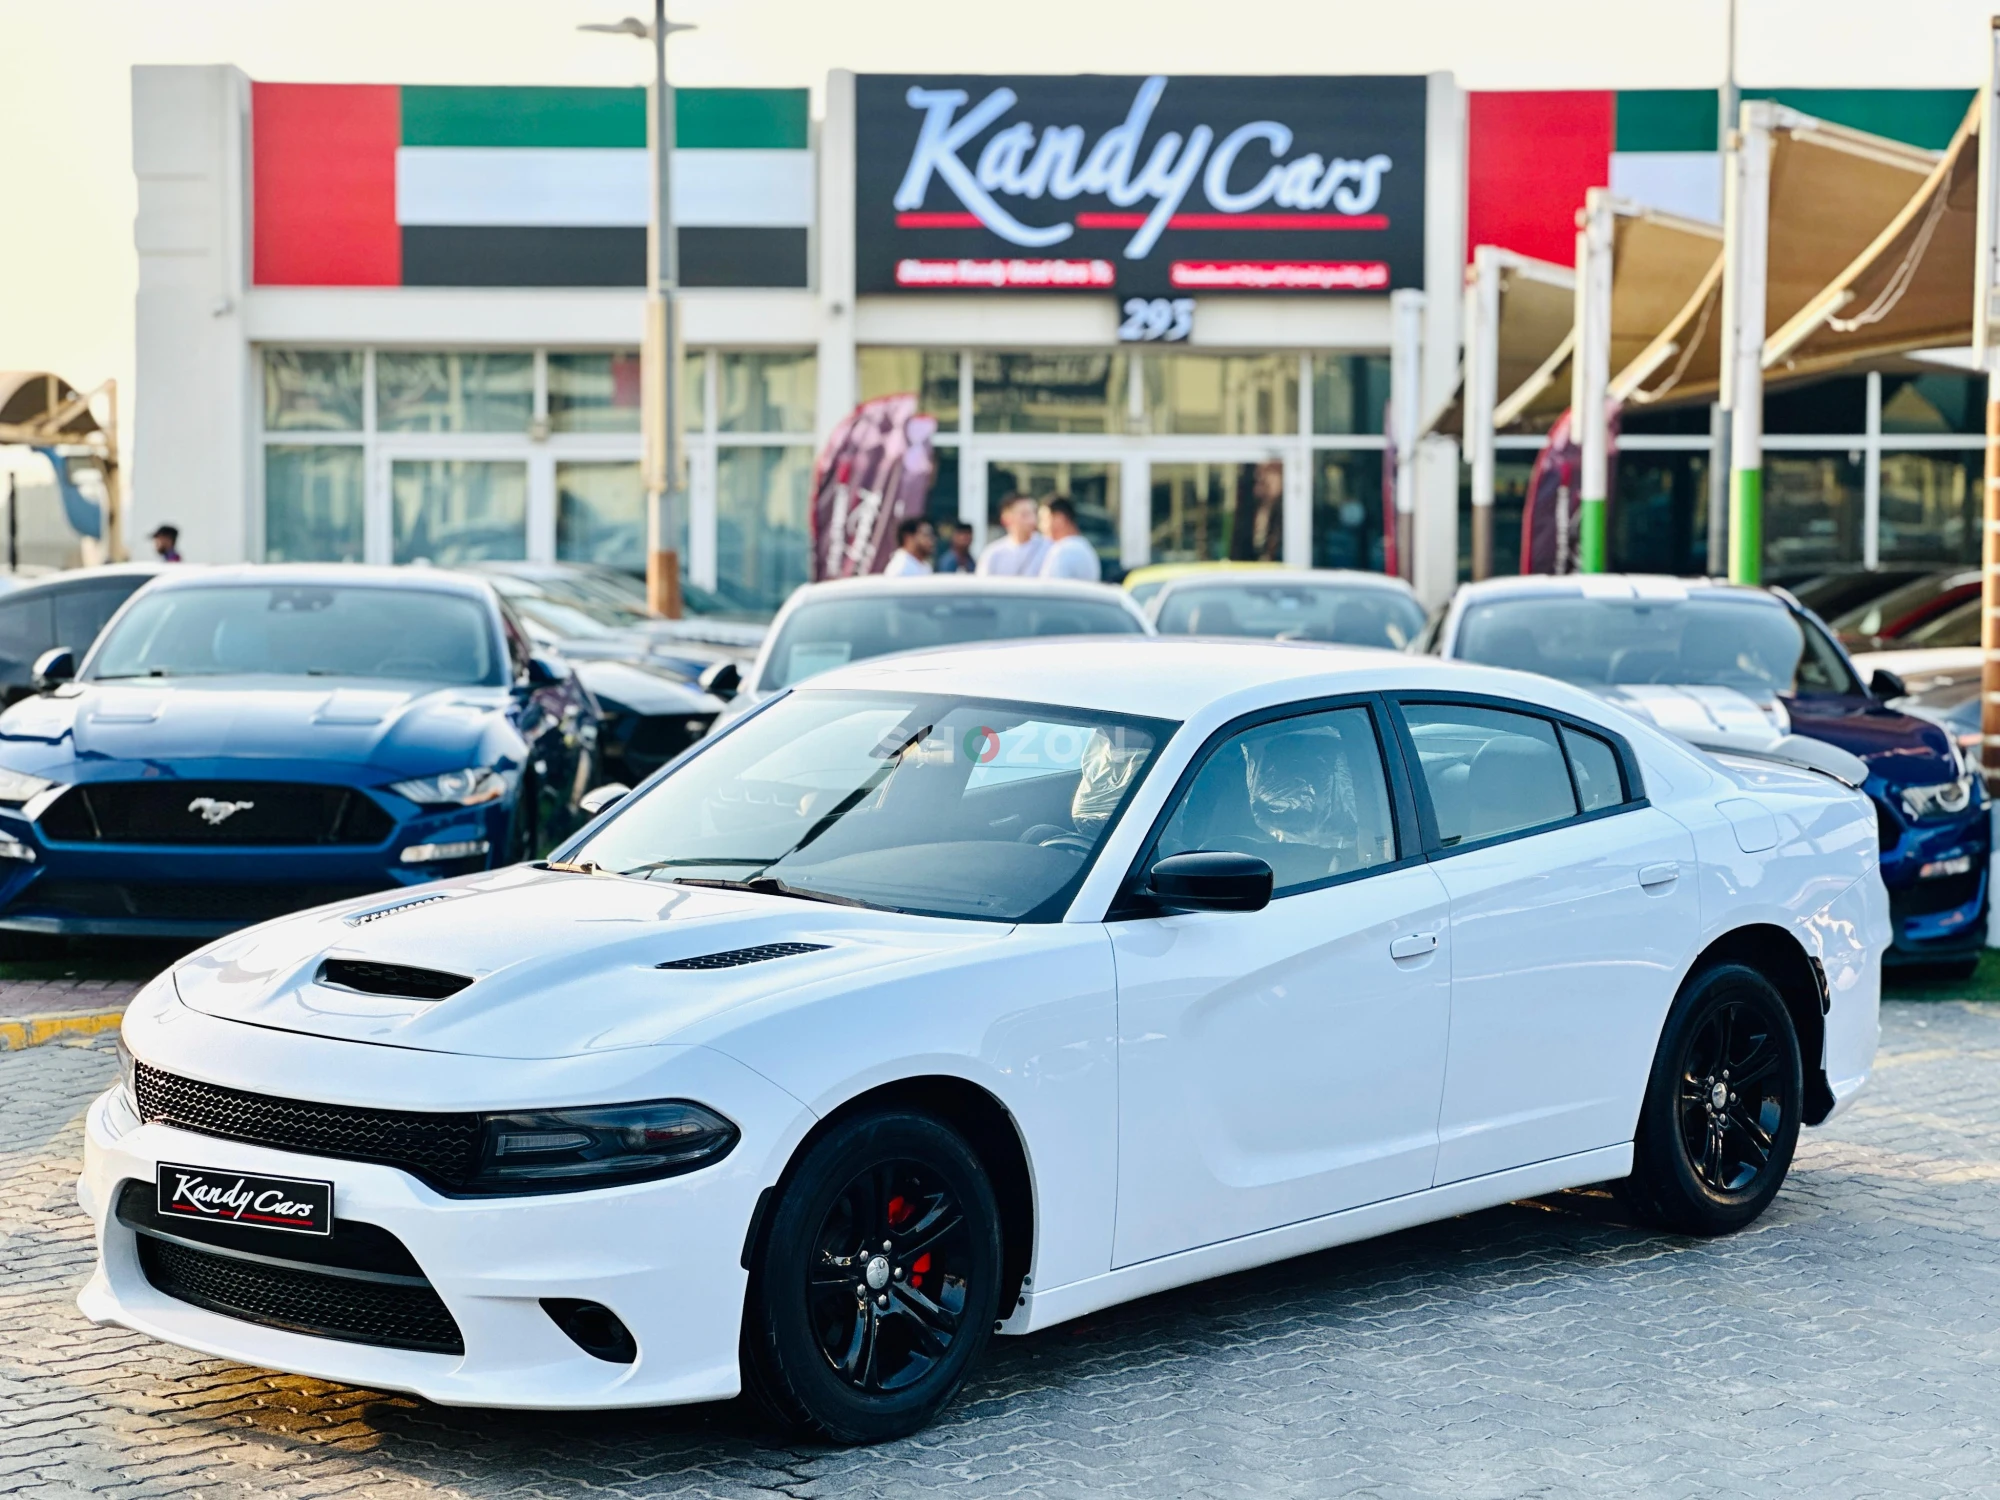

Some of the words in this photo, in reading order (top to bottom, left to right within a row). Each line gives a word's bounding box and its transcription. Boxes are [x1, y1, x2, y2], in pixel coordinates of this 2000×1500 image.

[894, 76, 1214, 258] Kandy
[1203, 121, 1392, 214] Cars
[172, 1173, 254, 1219] Kandy
[254, 1190, 314, 1216] Cars
